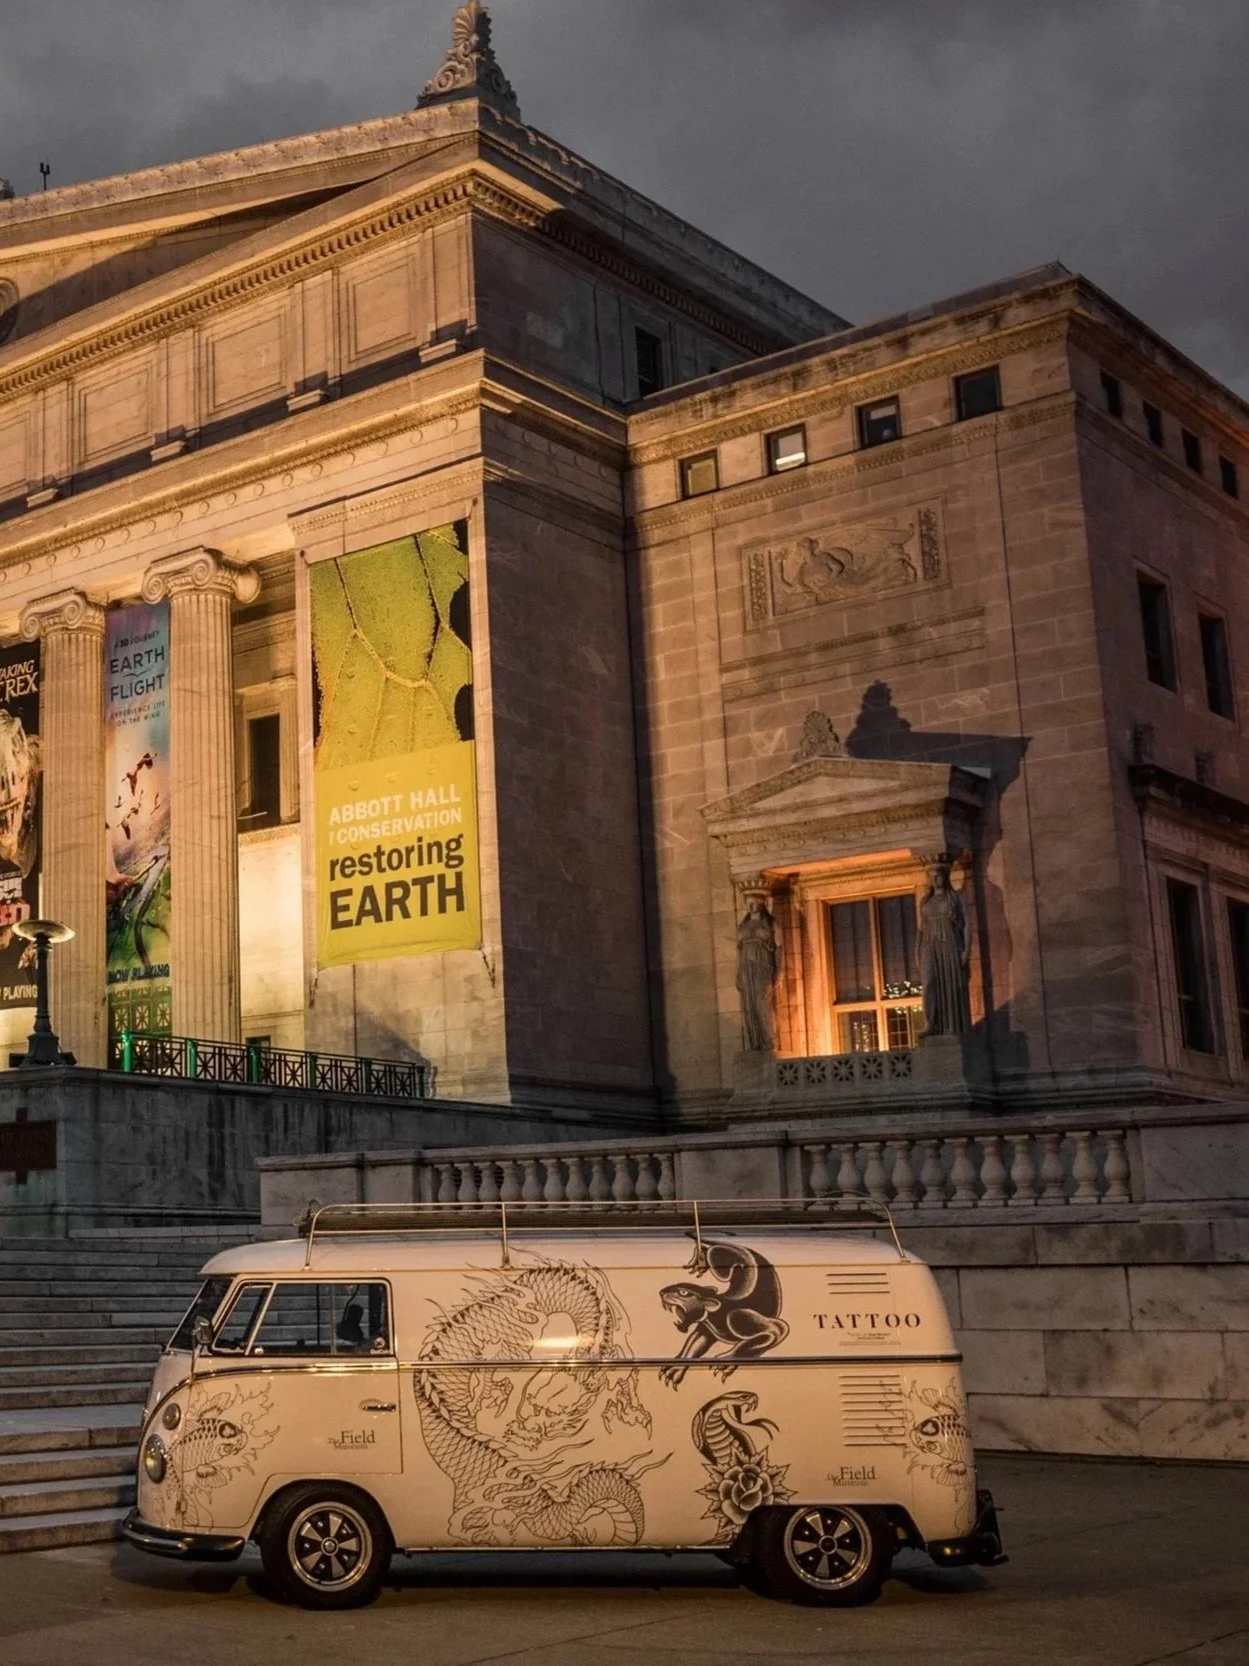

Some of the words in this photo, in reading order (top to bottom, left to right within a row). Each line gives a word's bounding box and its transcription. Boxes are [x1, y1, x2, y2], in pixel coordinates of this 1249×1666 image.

[120, 638, 129, 648] 3D
[110, 645, 165, 674] EARTH
[110, 673, 165, 702] FLIGHT
[110, 704, 150, 720] EXPERIENCE
[129, 715, 140, 723] THE
[329, 794, 403, 826] ABBOTT
[410, 783, 462, 810] HALL
[336, 807, 462, 845] CONSERVATION
[329, 833, 464, 882] restoring
[330, 871, 465, 931] EARTH
[108, 969, 128, 984] NOW
[131, 963, 170, 981] PLAYING
[3, 984, 38, 1001] PLAYING
[813, 1313, 921, 1329] TATTOO
[341, 1429, 376, 1444] Field
[840, 1465, 876, 1480] Field
